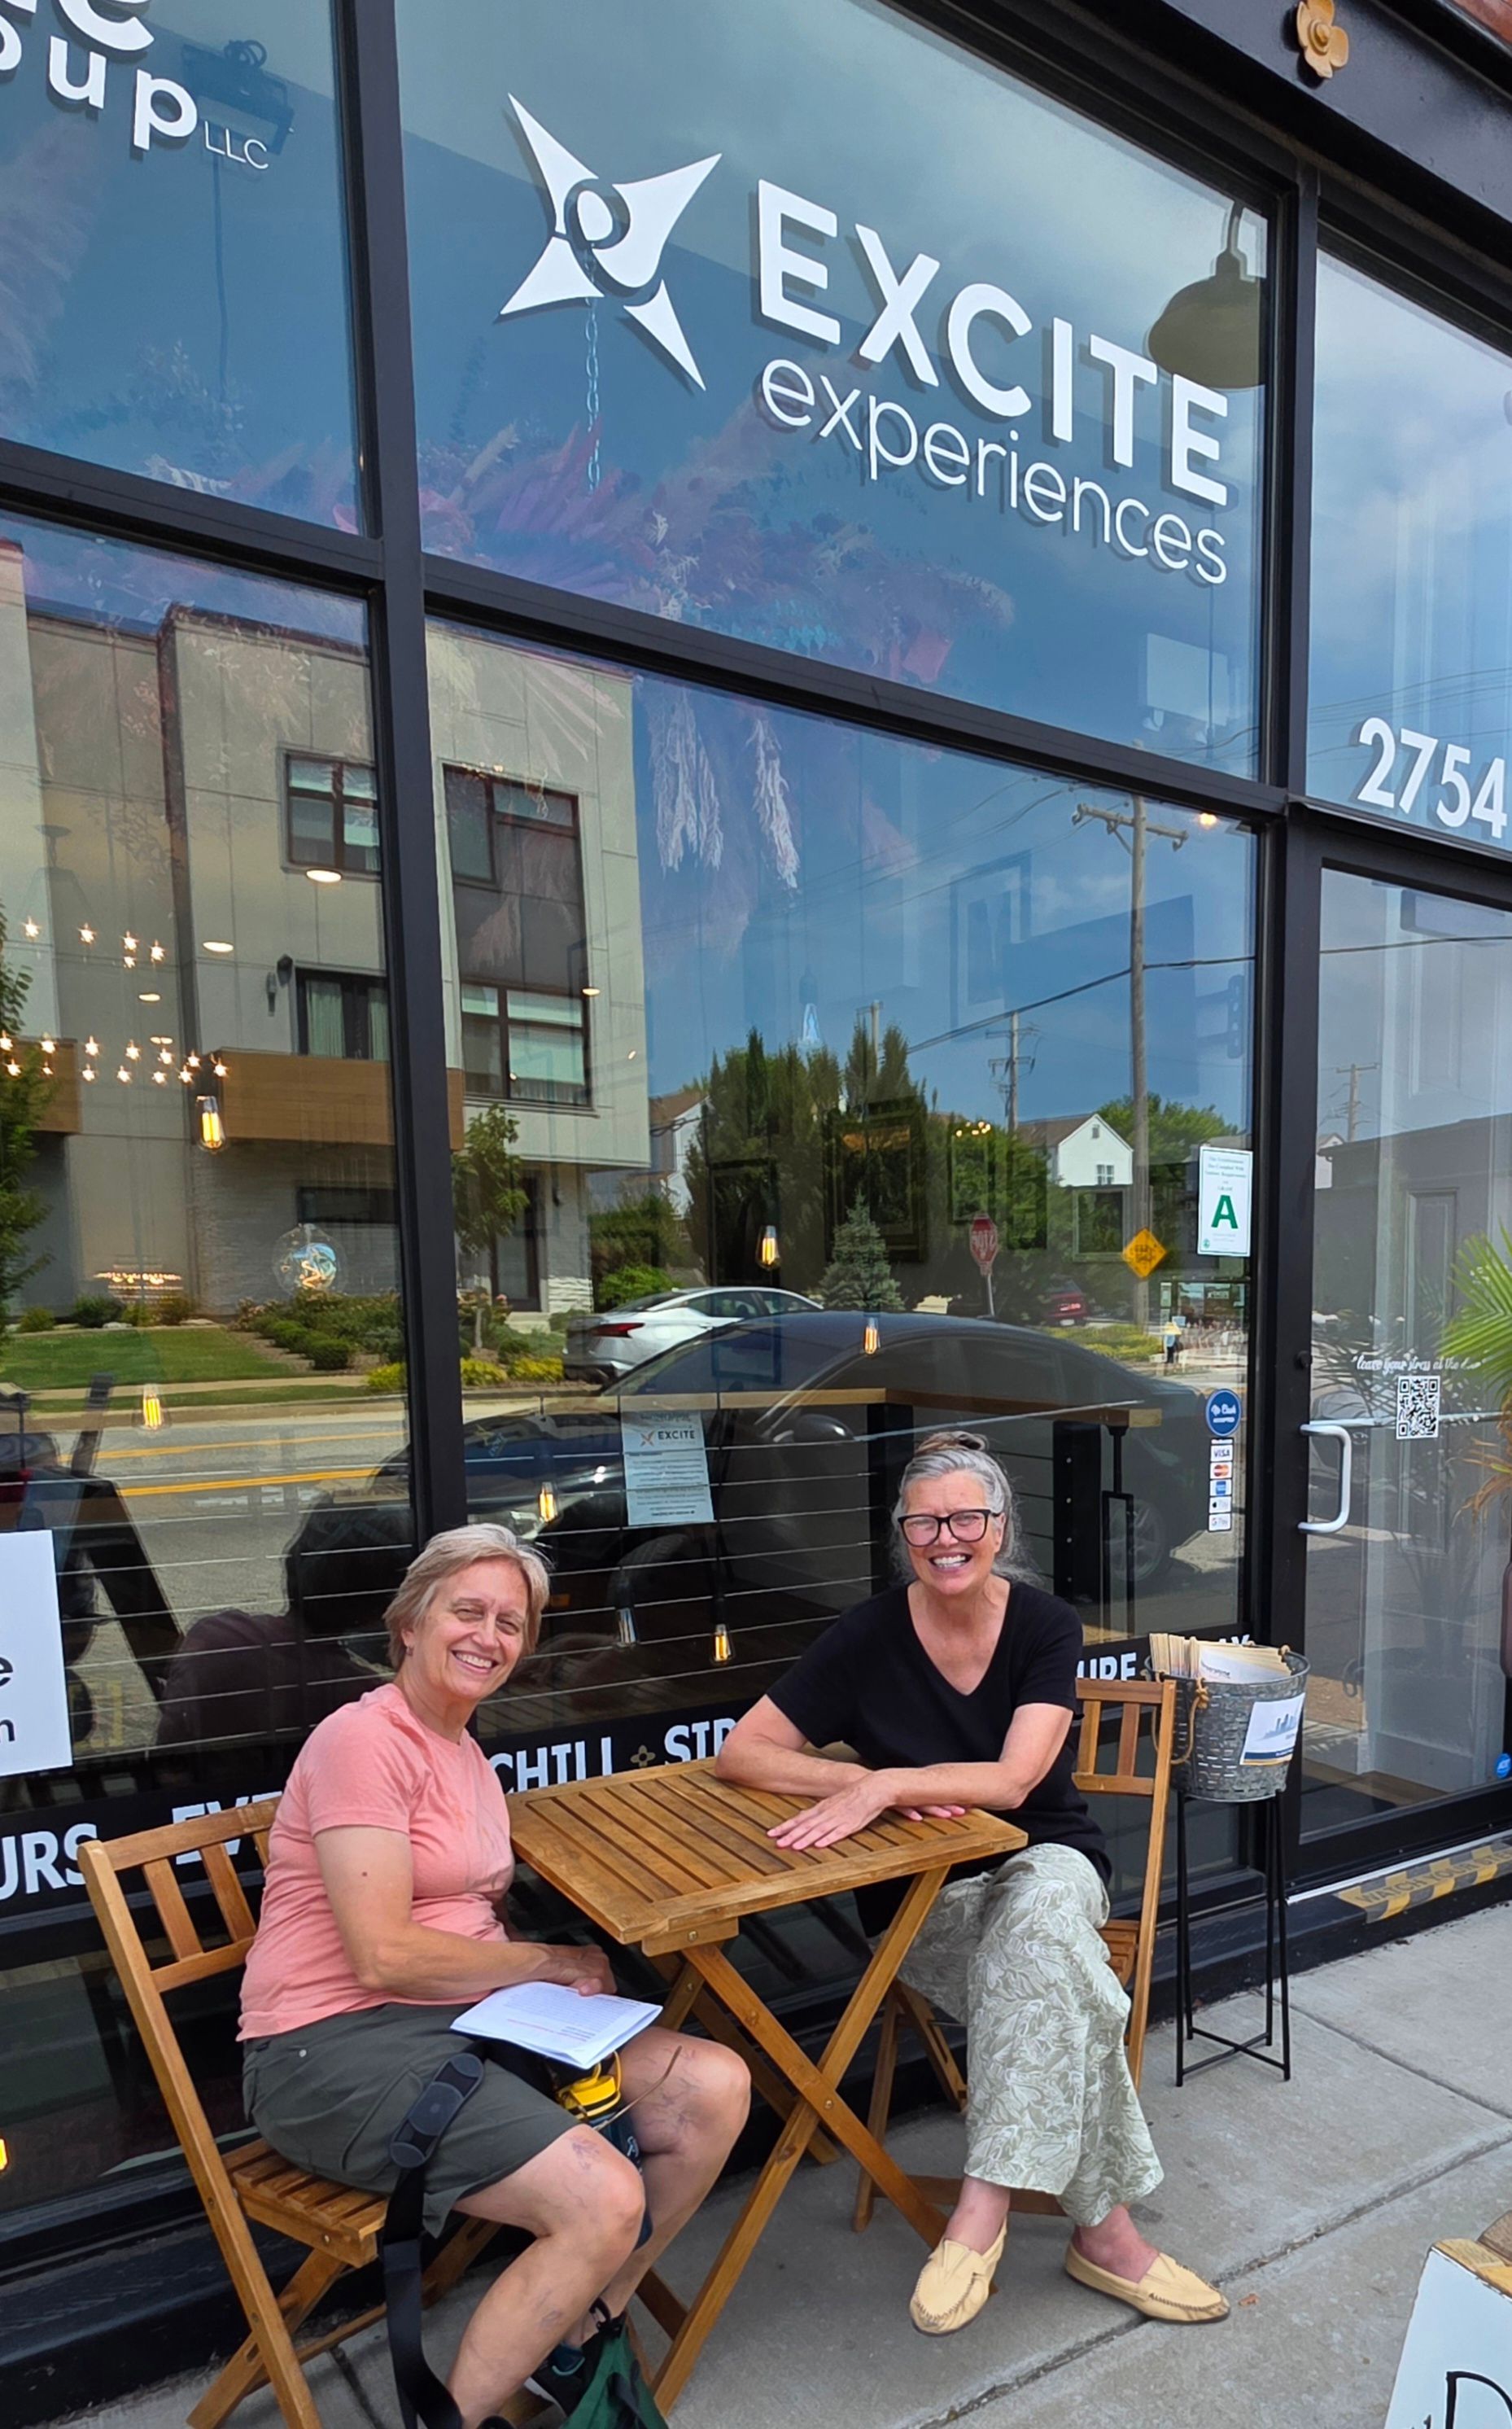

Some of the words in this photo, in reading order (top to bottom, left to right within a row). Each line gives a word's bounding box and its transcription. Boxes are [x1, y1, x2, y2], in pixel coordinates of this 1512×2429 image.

[203, 120, 269, 170] LLC
[758, 179, 1228, 505] EXCITE
[762, 358, 1227, 584] experiences
[1357, 717, 1508, 838] 2754
[1211, 1194, 1239, 1229] A
[658, 1429, 695, 1440] EXCITE
[1214, 1449, 1230, 1458] VISA
[1355, 1880, 1427, 1903] WATCH
[1427, 1862, 1478, 1882] YOUR
